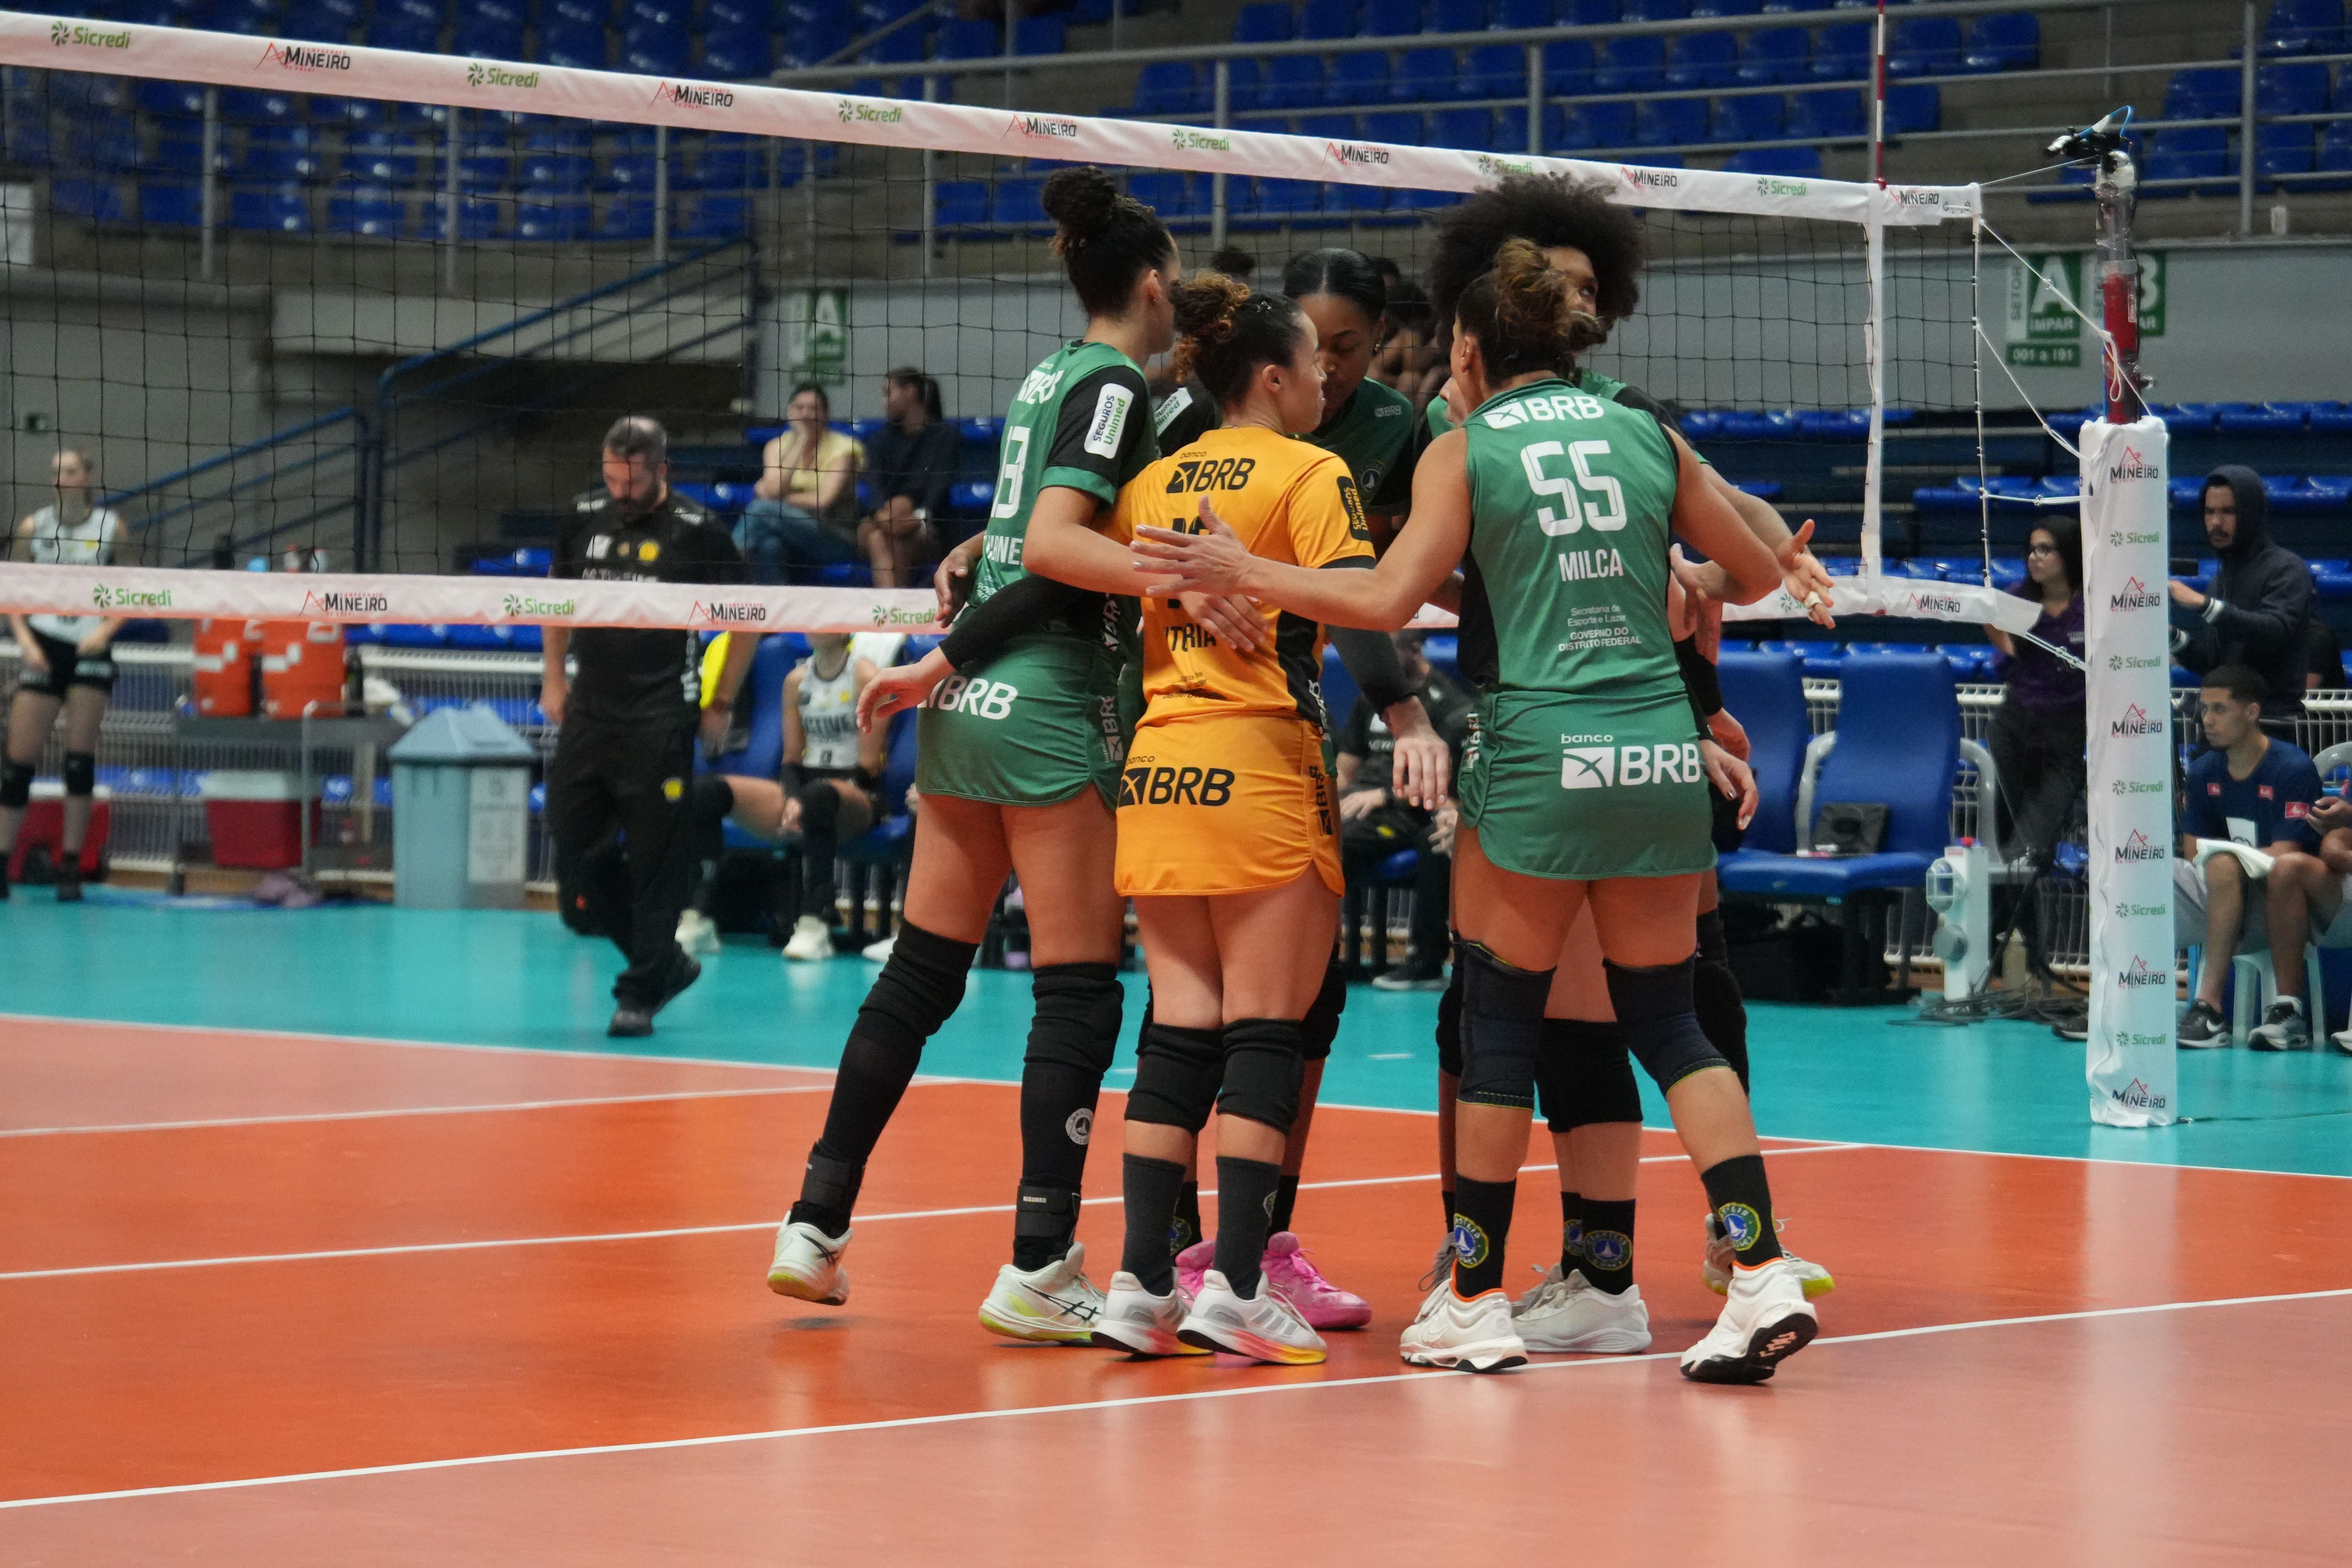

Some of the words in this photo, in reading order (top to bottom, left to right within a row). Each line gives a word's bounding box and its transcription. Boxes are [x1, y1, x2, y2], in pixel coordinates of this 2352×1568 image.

[73, 25, 131, 49] Sicredi
[285, 46, 350, 70] MINEIRO
[487, 68, 539, 89] Sicredi
[674, 84, 733, 107] MINEIRO
[856, 104, 902, 123] Sicredi
[1026, 117, 1076, 137] MINEIRO
[1188, 132, 1230, 151] Sicredi
[1340, 145, 1389, 164] MINEIRO
[1633, 169, 1677, 187] MINEIRO
[1771, 180, 1807, 196] Sicredi
[1900, 190, 1939, 205] MINEIRO
[2030, 255, 2072, 313] A
[1093, 394, 1115, 442] SEGUROS
[1525, 395, 1604, 422] BRB
[1104, 398, 1126, 446] Unimed
[1194, 458, 1256, 492] BRB
[2110, 465, 2158, 481] MINEIRO
[1520, 440, 1628, 537] 55
[2126, 532, 2159, 544] Sicredi
[1559, 548, 1625, 582] MILCA
[115, 588, 172, 606] Sicredi
[325, 592, 387, 612] MINEIRO
[525, 598, 575, 615] Sicredi
[1920, 594, 1960, 613] MINEIRO
[2110, 594, 2160, 608] MINEIRO
[710, 602, 766, 621] MINEIRO
[890, 607, 936, 624] Sicredi
[1570, 628, 1612, 640] GOVERNO
[1614, 627, 1629, 635] DO
[1559, 639, 1601, 652] DISTRITO
[1601, 635, 1642, 647] FEDERAL
[2126, 656, 2161, 668] Sicredi
[938, 676, 1018, 720] BRB
[2112, 721, 2162, 735] MINEIRO
[1561, 733, 1613, 744] banco
[1127, 755, 1155, 764] banco
[1619, 743, 1701, 786] BRB
[1149, 767, 1235, 806] BRB
[2129, 781, 2164, 793] Sicredi
[2115, 846, 2164, 860] MINEIRO
[2131, 904, 2166, 916] Sicredi
[2118, 971, 2166, 985] MINEIRO
[2132, 1033, 2166, 1045] Sicredi
[2112, 1089, 2166, 1109] MINEIRO
